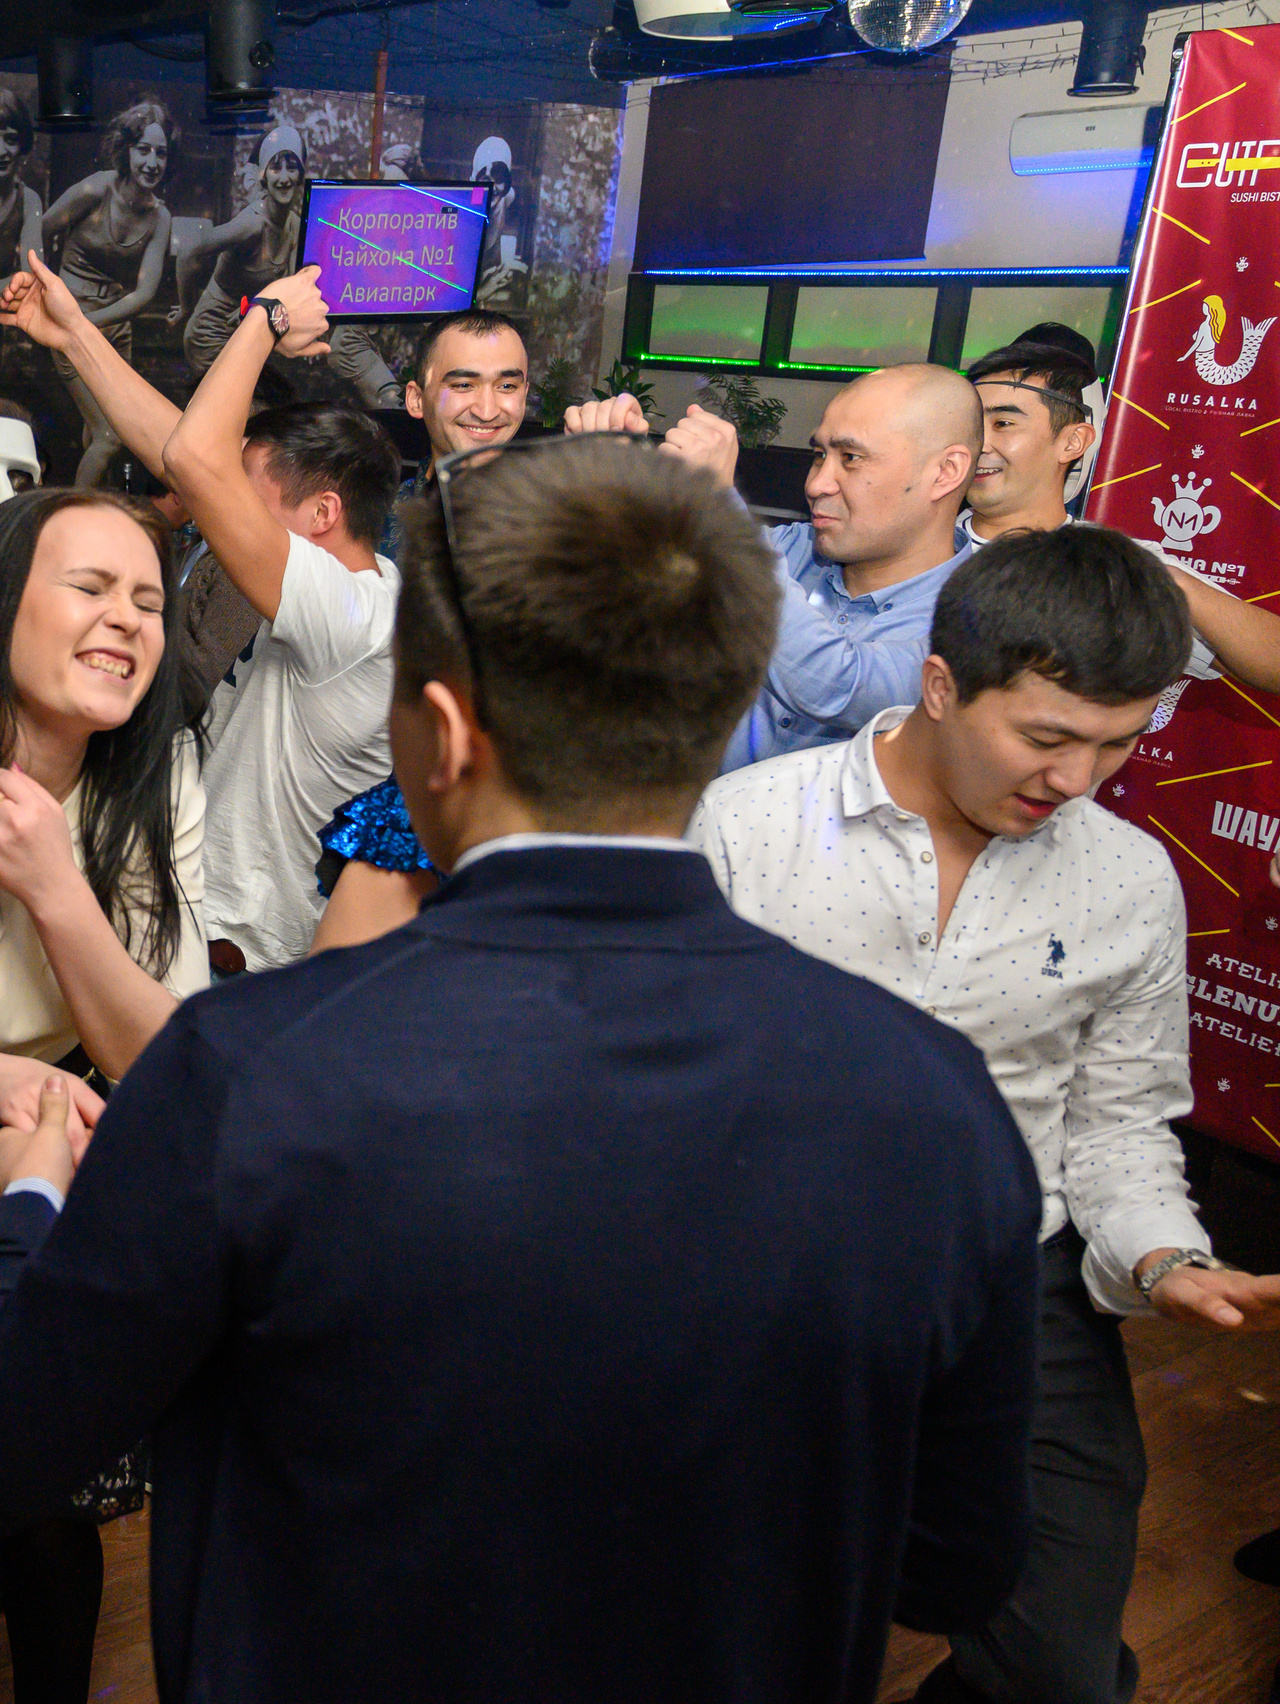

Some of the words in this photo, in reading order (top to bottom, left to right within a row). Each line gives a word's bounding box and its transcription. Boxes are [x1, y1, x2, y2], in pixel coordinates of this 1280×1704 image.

[1230, 192, 1260, 203] SUSHI
[338, 208, 458, 234] Корпоратив
[331, 245, 414, 267] Чайхона
[421, 245, 455, 266] №1
[340, 282, 437, 306] Авиапарк
[1166, 392, 1257, 410] RUSALKA
[1211, 561, 1246, 577] №1
[1138, 744, 1173, 761] LKA
[1211, 800, 1280, 854] ШАУ
